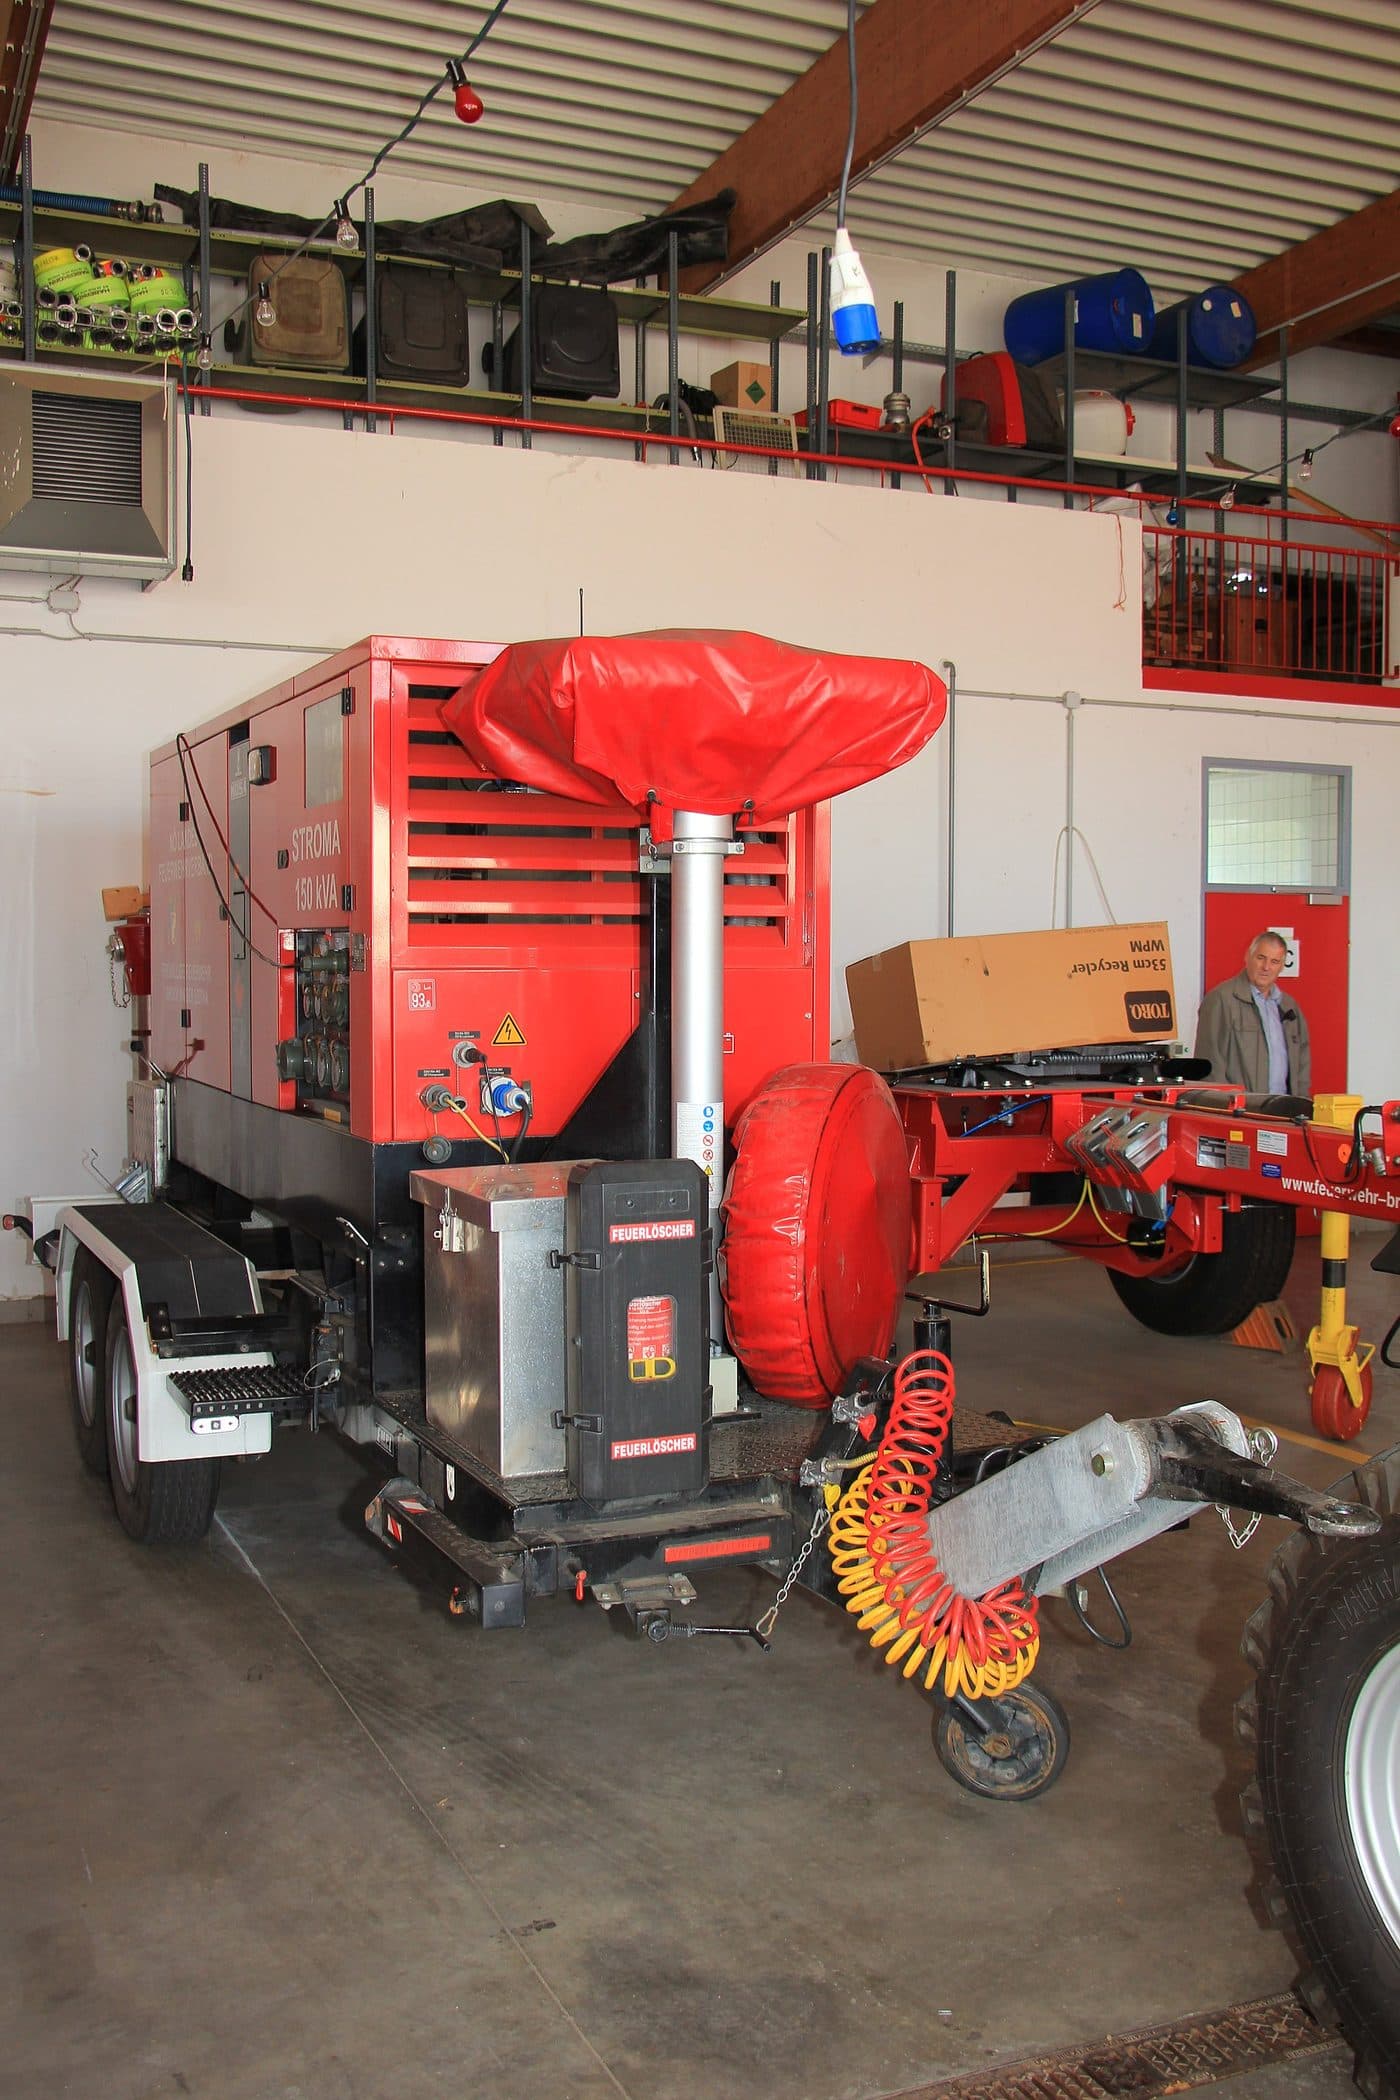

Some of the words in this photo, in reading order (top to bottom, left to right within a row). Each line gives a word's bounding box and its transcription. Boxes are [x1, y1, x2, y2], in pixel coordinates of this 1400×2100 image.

[292, 820, 341, 862] STROMA
[295, 876, 313, 912] 150
[315, 873, 338, 910] kVA
[1130, 939, 1165, 952] WPM
[1133, 958, 1166, 971] 53cm
[411, 992, 425, 1008] 93
[1131, 1003, 1170, 1020] TORO
[612, 1223, 693, 1242] FEUERLÖSCHER
[613, 1437, 695, 1459] FEUERLÖSCHER
